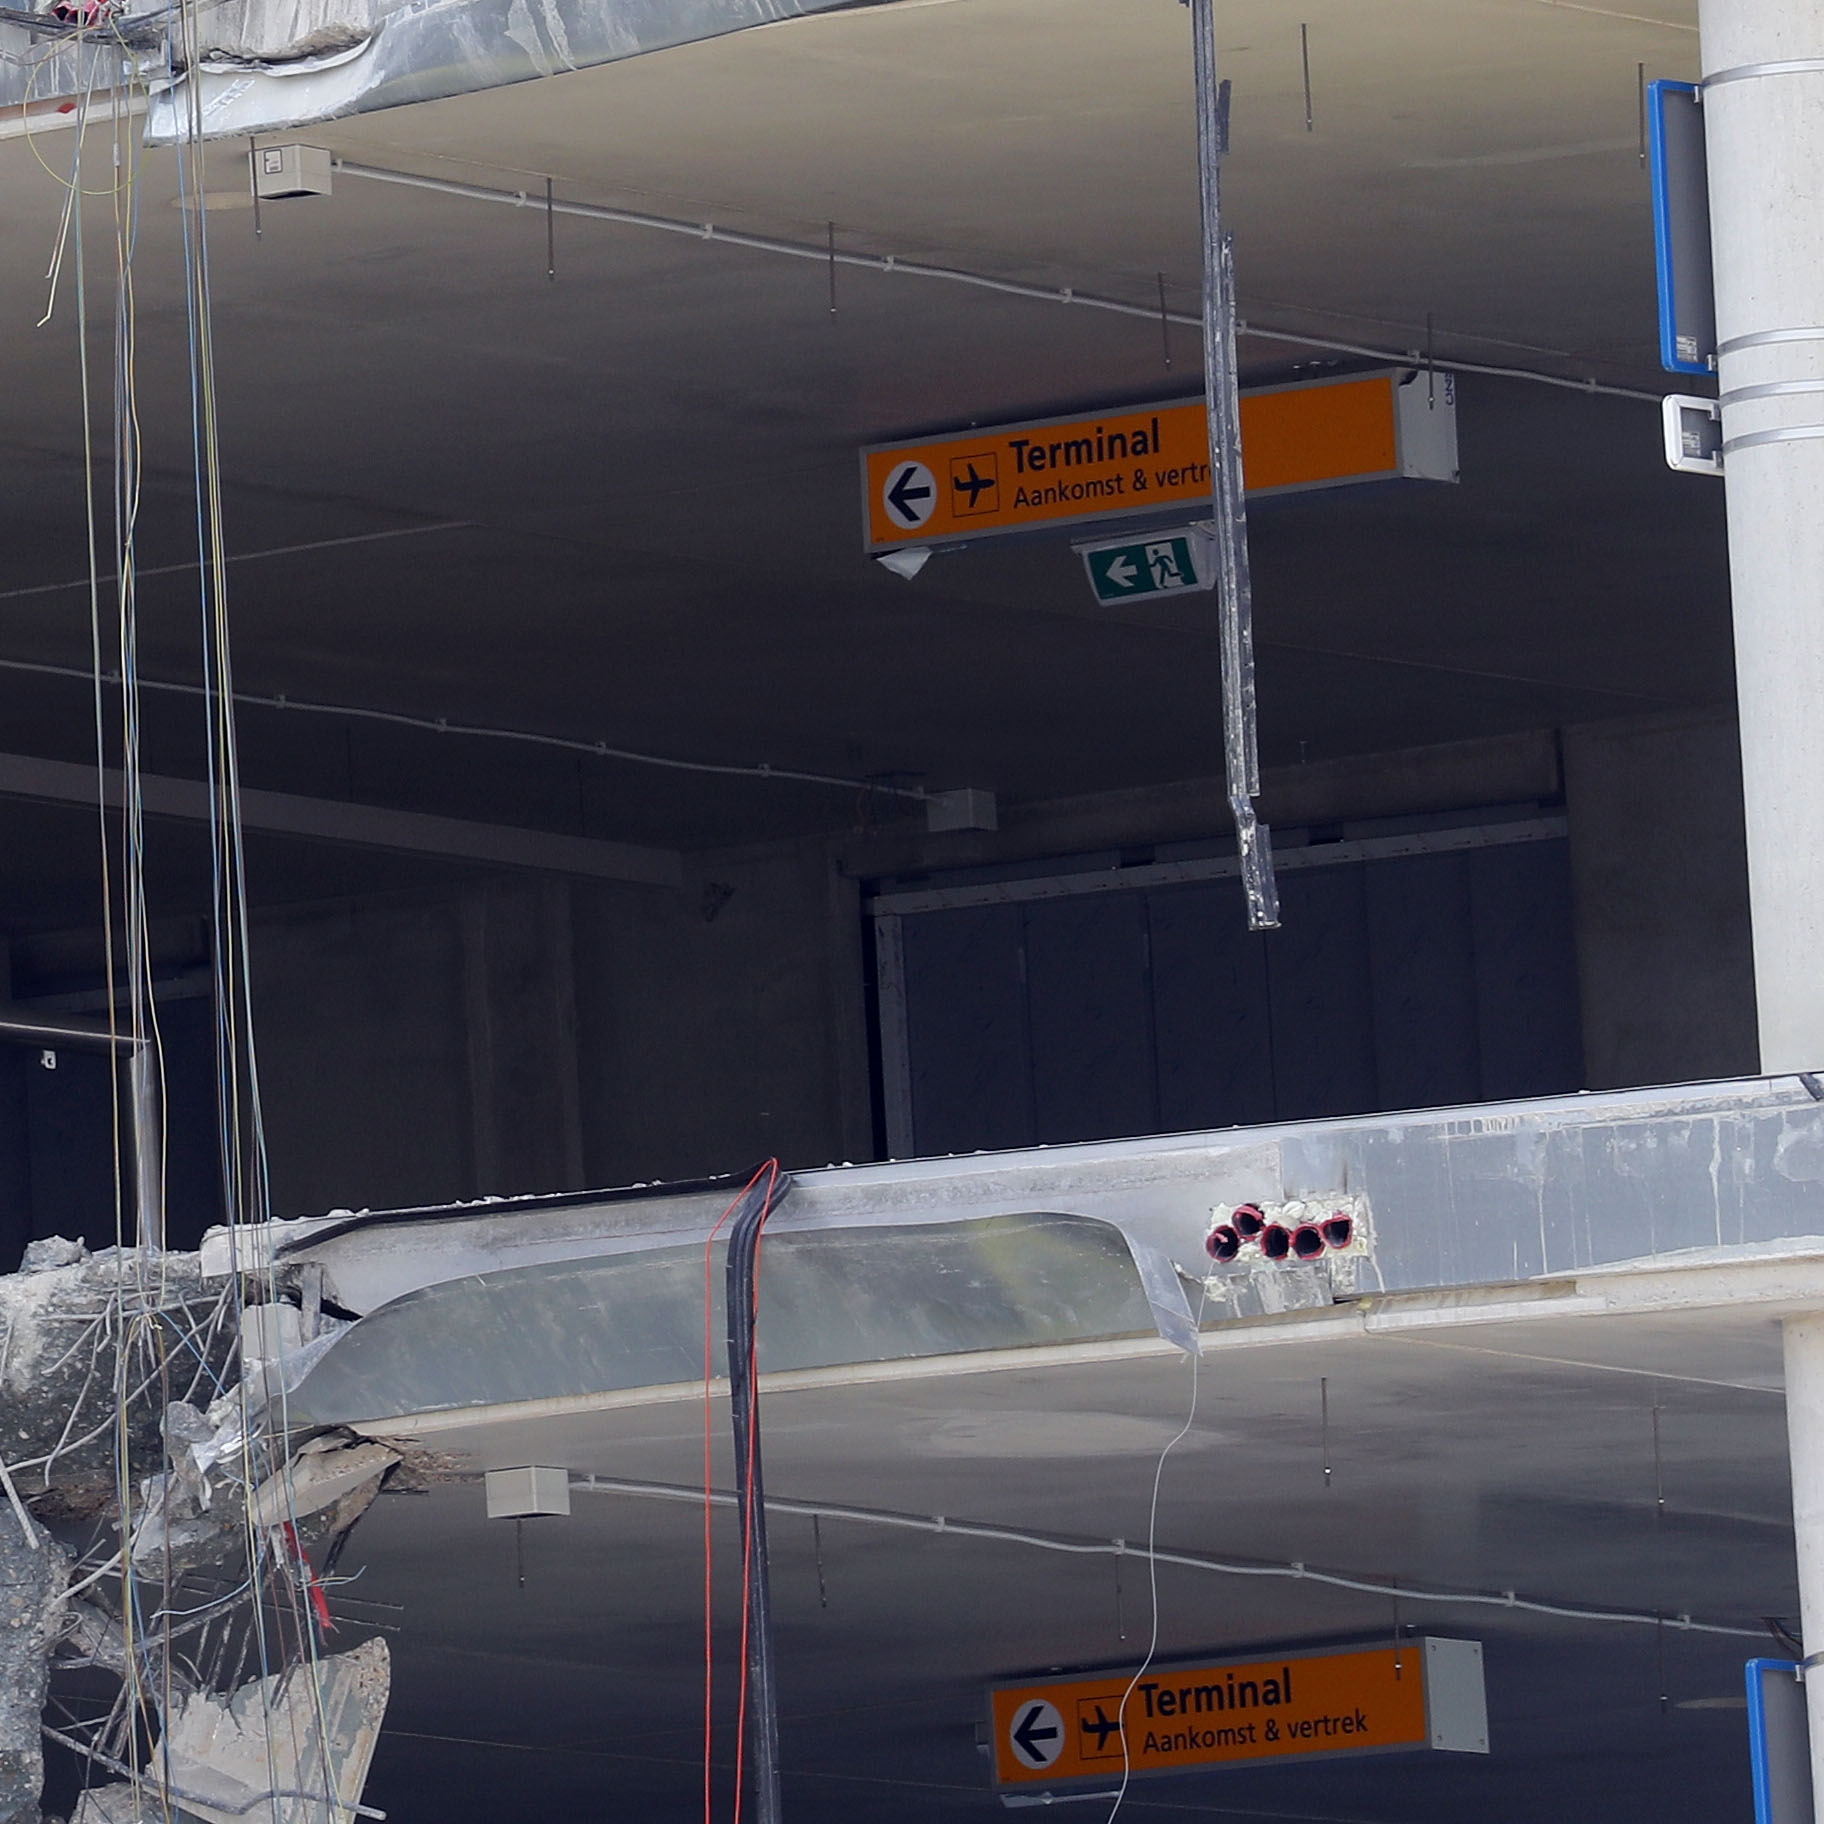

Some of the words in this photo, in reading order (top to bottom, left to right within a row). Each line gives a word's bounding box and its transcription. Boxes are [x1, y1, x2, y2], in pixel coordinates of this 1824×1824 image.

[1009, 418, 1159, 473] Terminal
[1014, 474, 1124, 508] Aankomst
[1133, 469, 1147, 491] &
[1155, 463, 1211, 487] vertr
[1138, 1667, 1291, 1717] Terminal
[1144, 1724, 1256, 1753] Aankomst
[1265, 1719, 1280, 1741] &
[1288, 1709, 1368, 1738] vertrek
